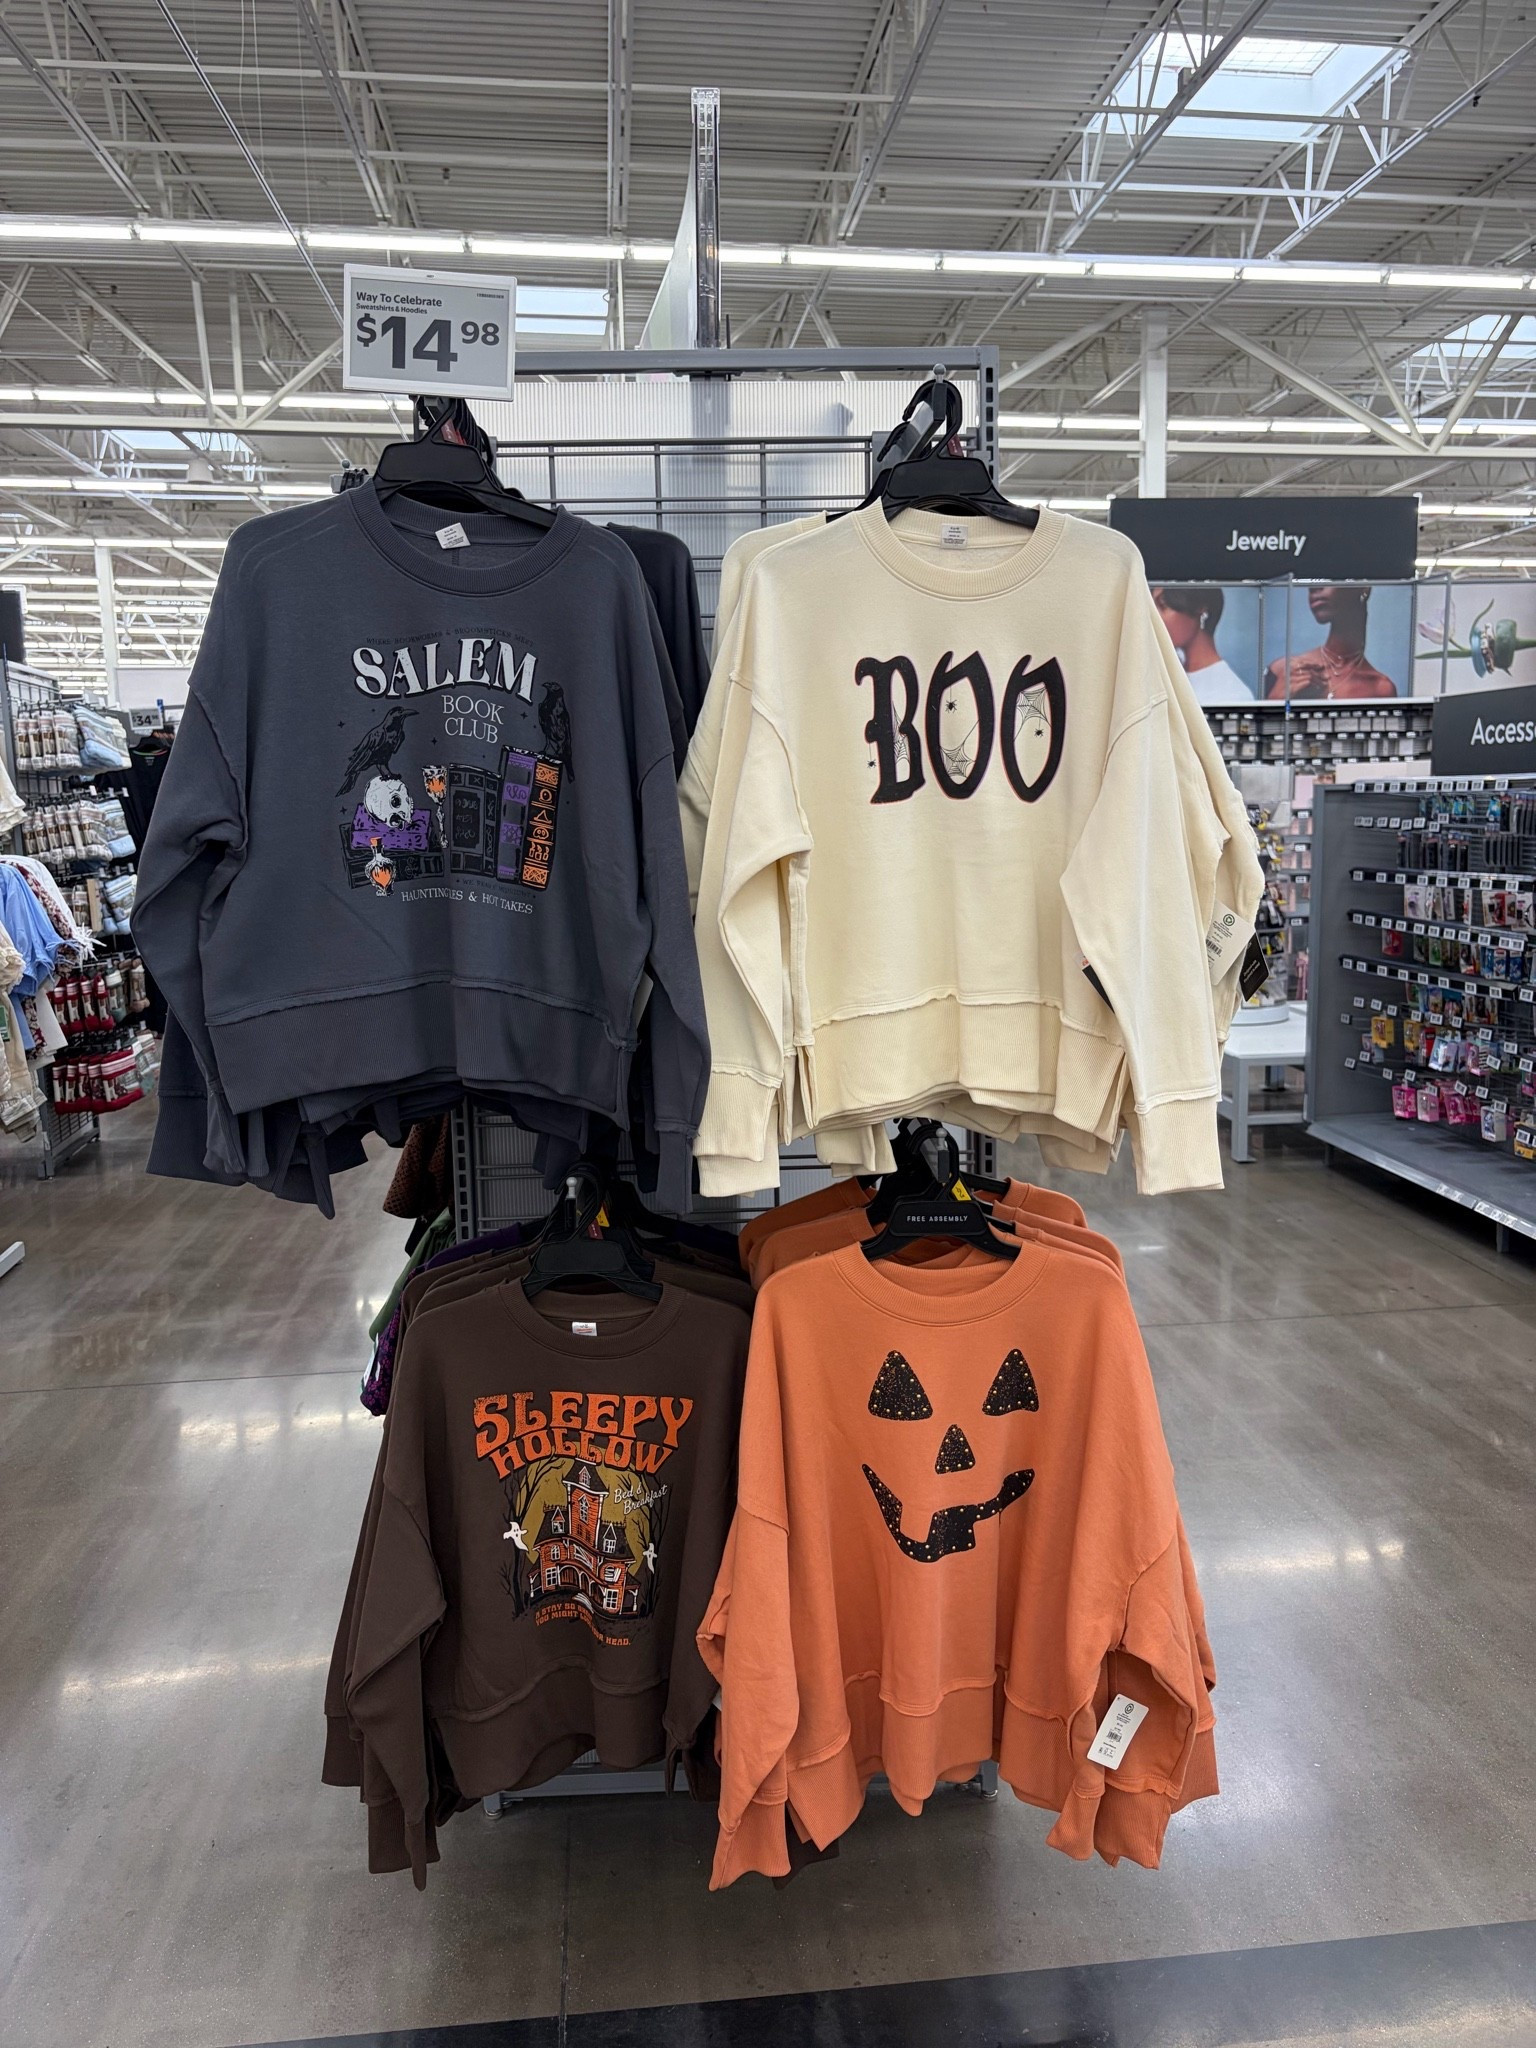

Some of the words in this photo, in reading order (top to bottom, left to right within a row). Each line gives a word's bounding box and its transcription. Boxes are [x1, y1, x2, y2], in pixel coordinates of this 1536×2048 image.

[356, 291, 378, 304] Way
[380, 293, 392, 303] To
[393, 294, 443, 307] Celebrate
[356, 303, 395, 312] Sweatshirts
[400, 306, 428, 314] Hoodies
[1225, 529, 1307, 557] Jewelry
[353, 637, 538, 703] SALEM
[441, 694, 505, 725] BOOK
[445, 717, 499, 744] CLUB
[854, 650, 1067, 804] BOO
[1470, 716, 1536, 746] Access
[468, 891, 478, 902] &
[482, 893, 499, 907] HOT
[500, 898, 533, 915] TAKES
[474, 1391, 694, 1459] SLEEPY
[489, 1427, 674, 1480] HOLLOW
[614, 1485, 634, 1504] Bed
[623, 1484, 668, 1515] Breakfast
[535, 1614, 549, 1627] YOU
[551, 1610, 579, 1619] MIGHT
[541, 1603, 563, 1614] STAY
